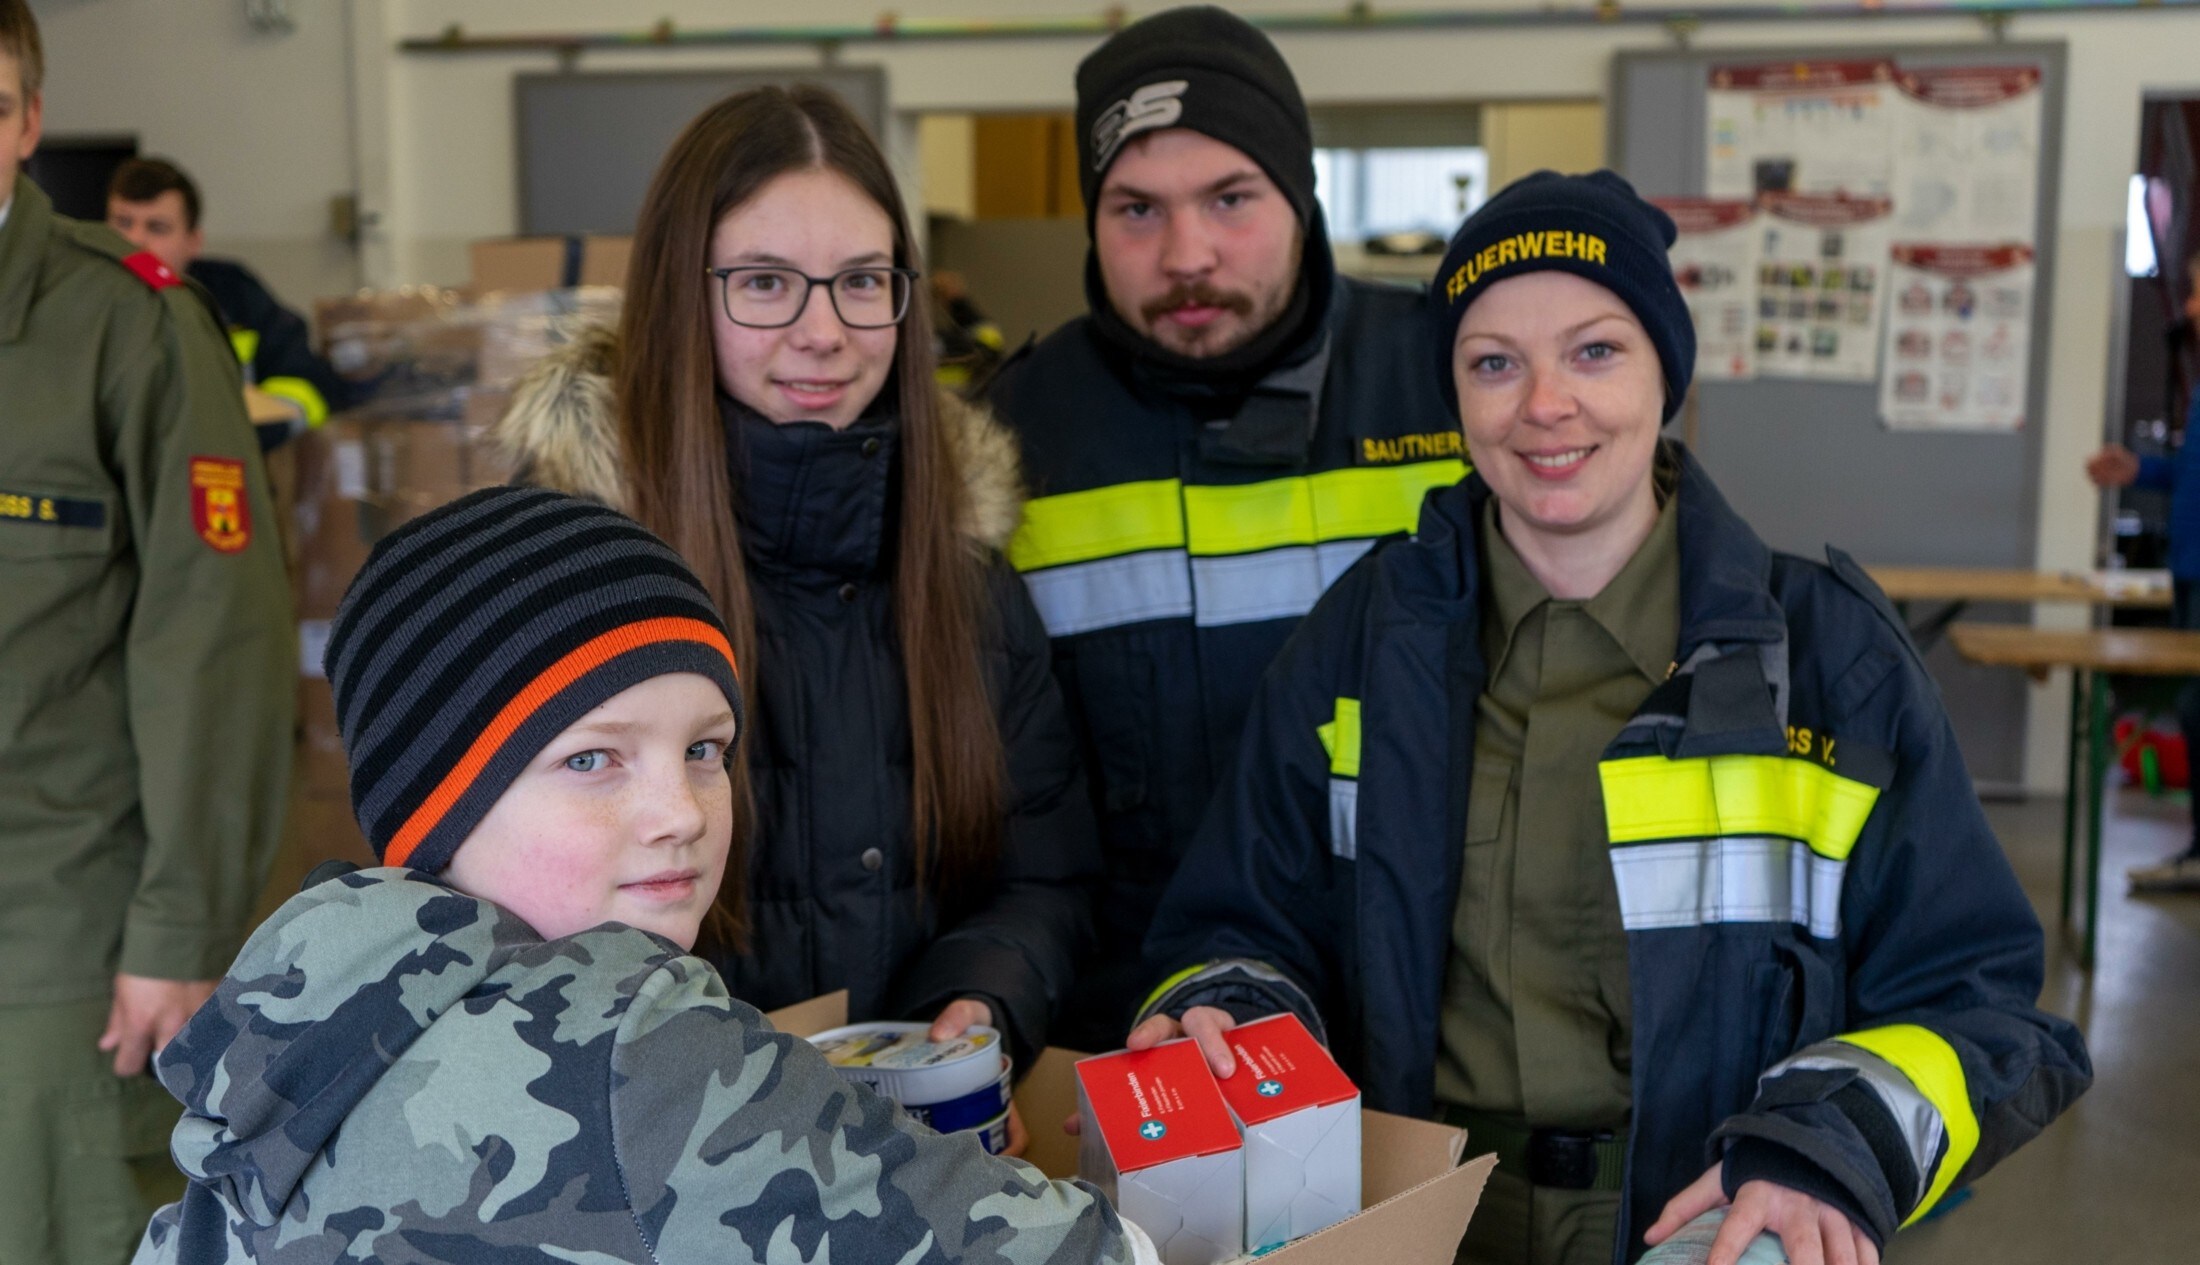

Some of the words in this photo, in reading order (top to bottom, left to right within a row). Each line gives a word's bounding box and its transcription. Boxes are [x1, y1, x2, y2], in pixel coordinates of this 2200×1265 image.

[1446, 230, 1607, 305] FEUERWEHR
[1363, 431, 1462, 462] SAUTNER
[1821, 735, 1836, 767] V.
[1127, 1072, 1152, 1118] Fixierbinden
